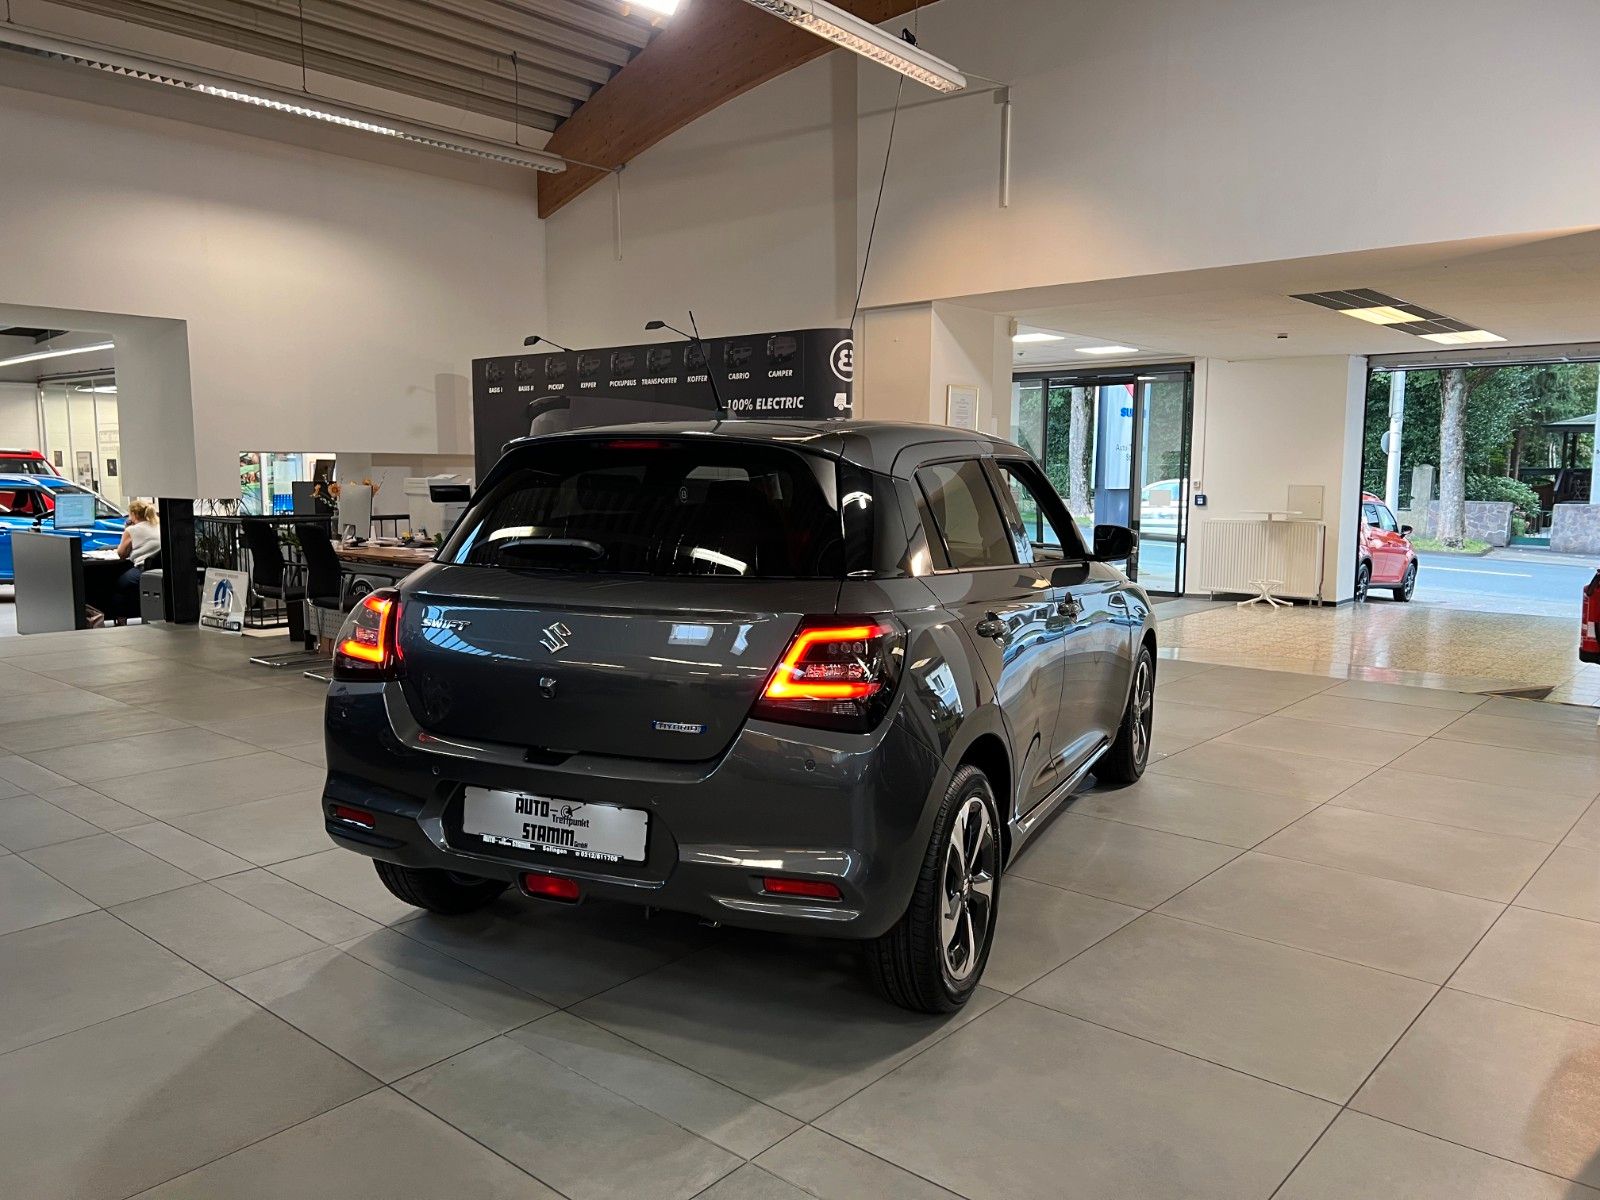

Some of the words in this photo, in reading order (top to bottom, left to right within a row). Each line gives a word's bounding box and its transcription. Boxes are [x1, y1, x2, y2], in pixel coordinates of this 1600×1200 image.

[728, 372, 750, 380] CABRIO
[768, 369, 793, 378] CAMPER
[609, 379, 637, 387] PICKUPBUS
[641, 377, 678, 386] TRANSPORTER
[687, 375, 708, 383] KOFFER
[727, 398, 753, 411] 100%
[756, 396, 805, 410] ELECTRIC
[421, 618, 471, 631] SWIFT
[552, 814, 590, 828] Treffpunkt
[522, 822, 575, 847] STAMM
